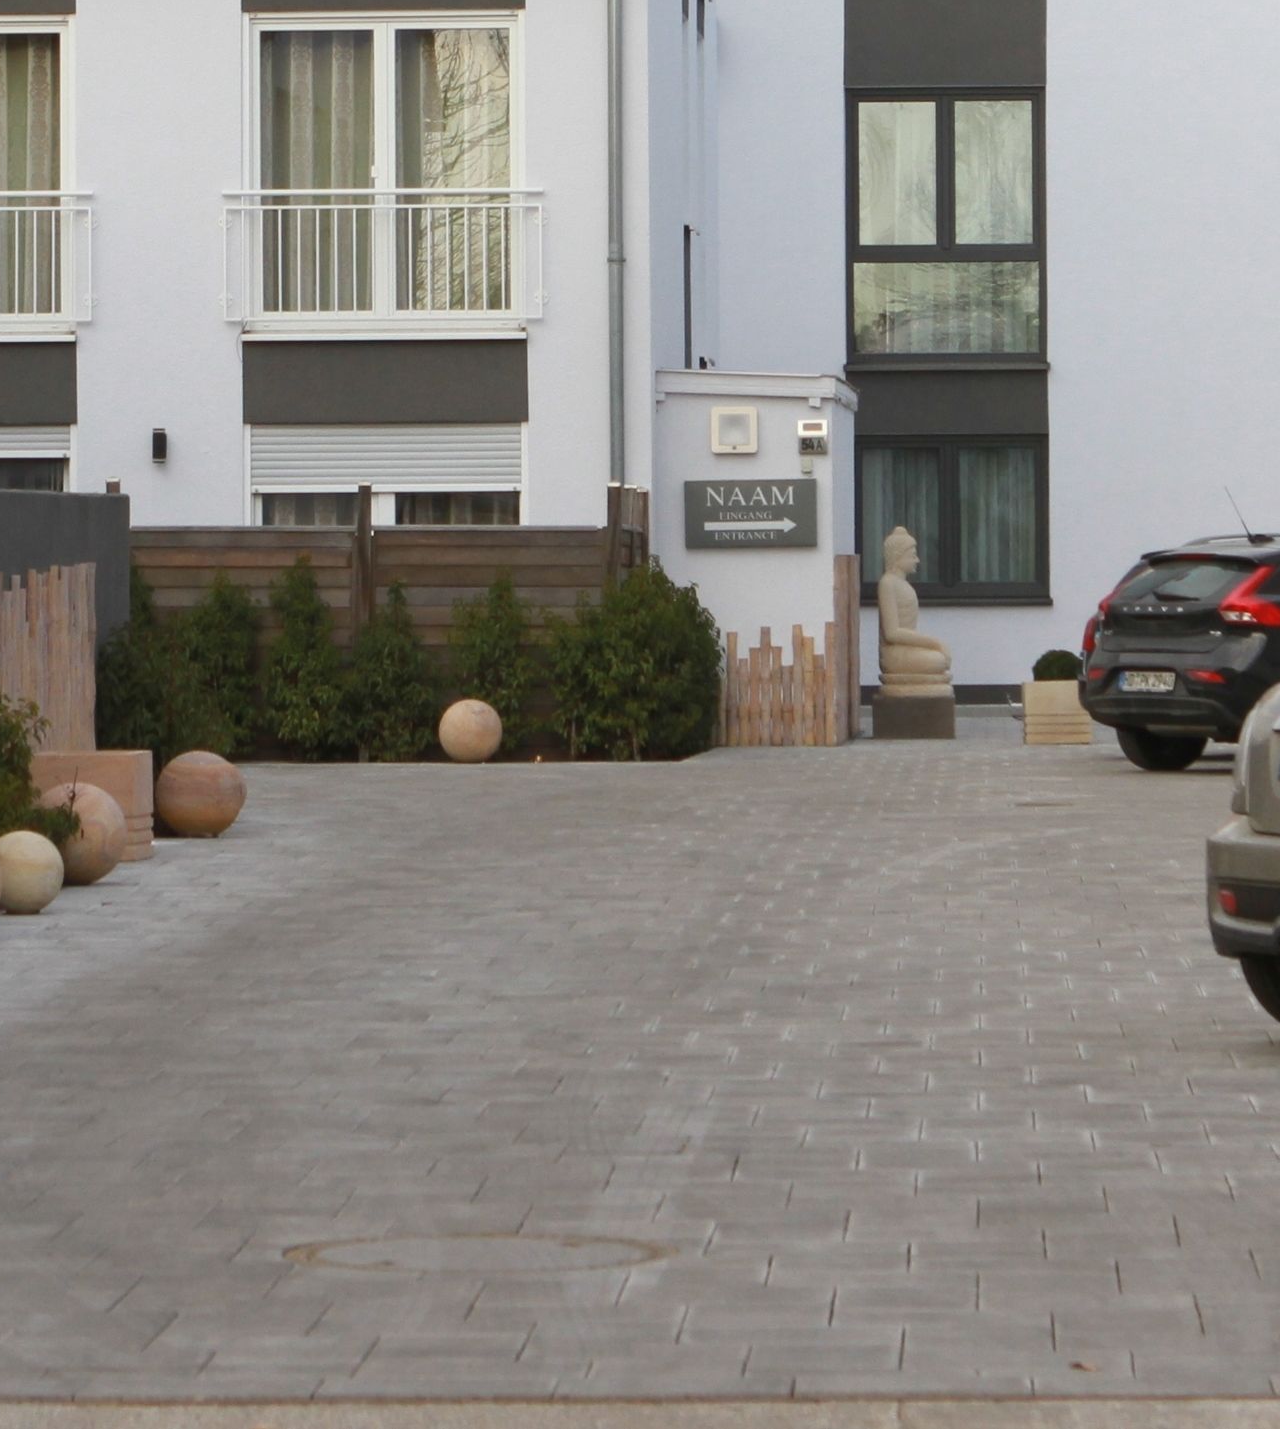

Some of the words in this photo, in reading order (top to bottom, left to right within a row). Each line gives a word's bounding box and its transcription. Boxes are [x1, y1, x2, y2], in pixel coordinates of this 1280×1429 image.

[706, 485, 795, 507] NAAM
[719, 510, 773, 521] EINGANG
[714, 531, 778, 541] ENTRANCE
